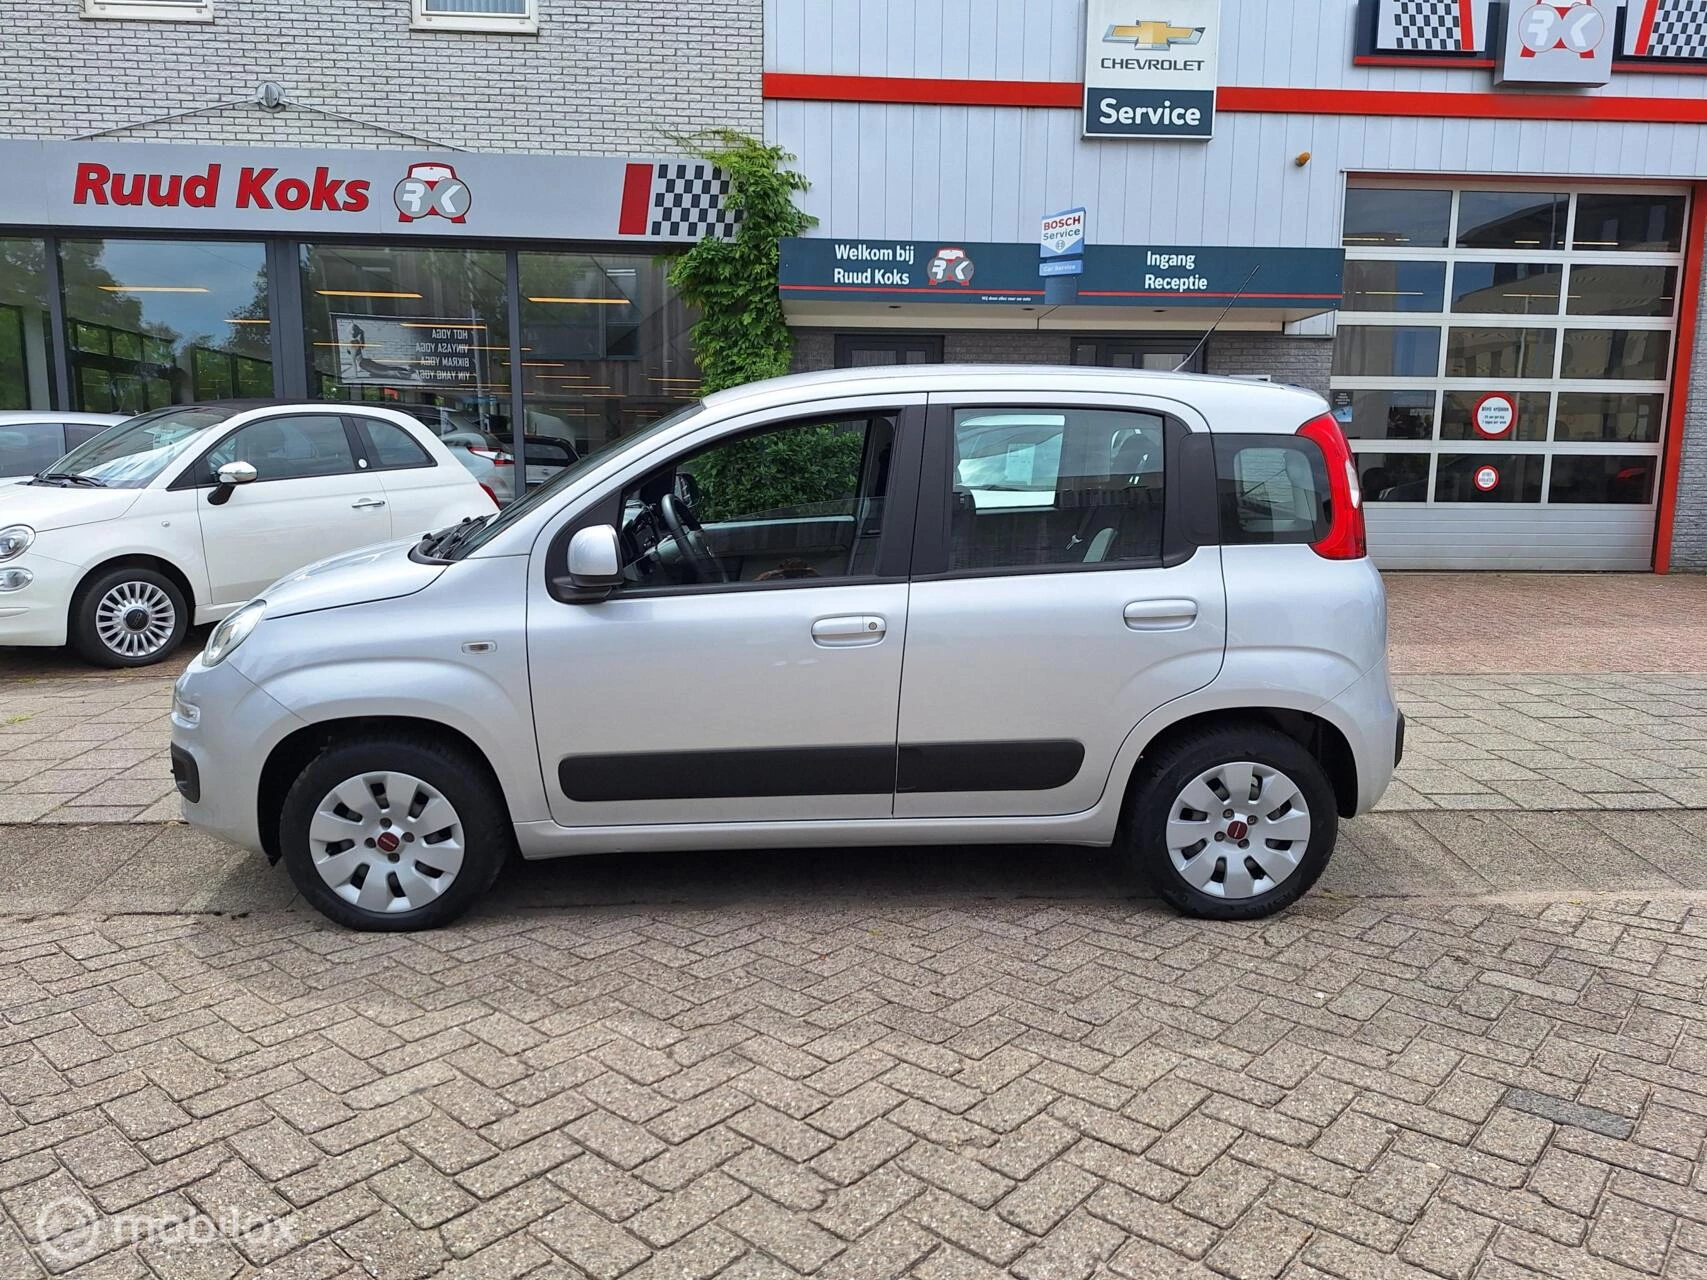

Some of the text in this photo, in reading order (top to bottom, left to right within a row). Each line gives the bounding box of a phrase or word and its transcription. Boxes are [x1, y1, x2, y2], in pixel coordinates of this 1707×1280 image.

[1101, 57, 1205, 71] CHEVROLET
[1099, 97, 1201, 126] Service
[72, 162, 371, 213] Ruud Koks
[1043, 215, 1081, 231] BOSCH
[1043, 228, 1080, 241] Service
[834, 244, 914, 264] Welkom bij
[1146, 250, 1196, 270] Ingang
[833, 268, 910, 285] Ruud Koks
[1144, 273, 1208, 292] Receptie
